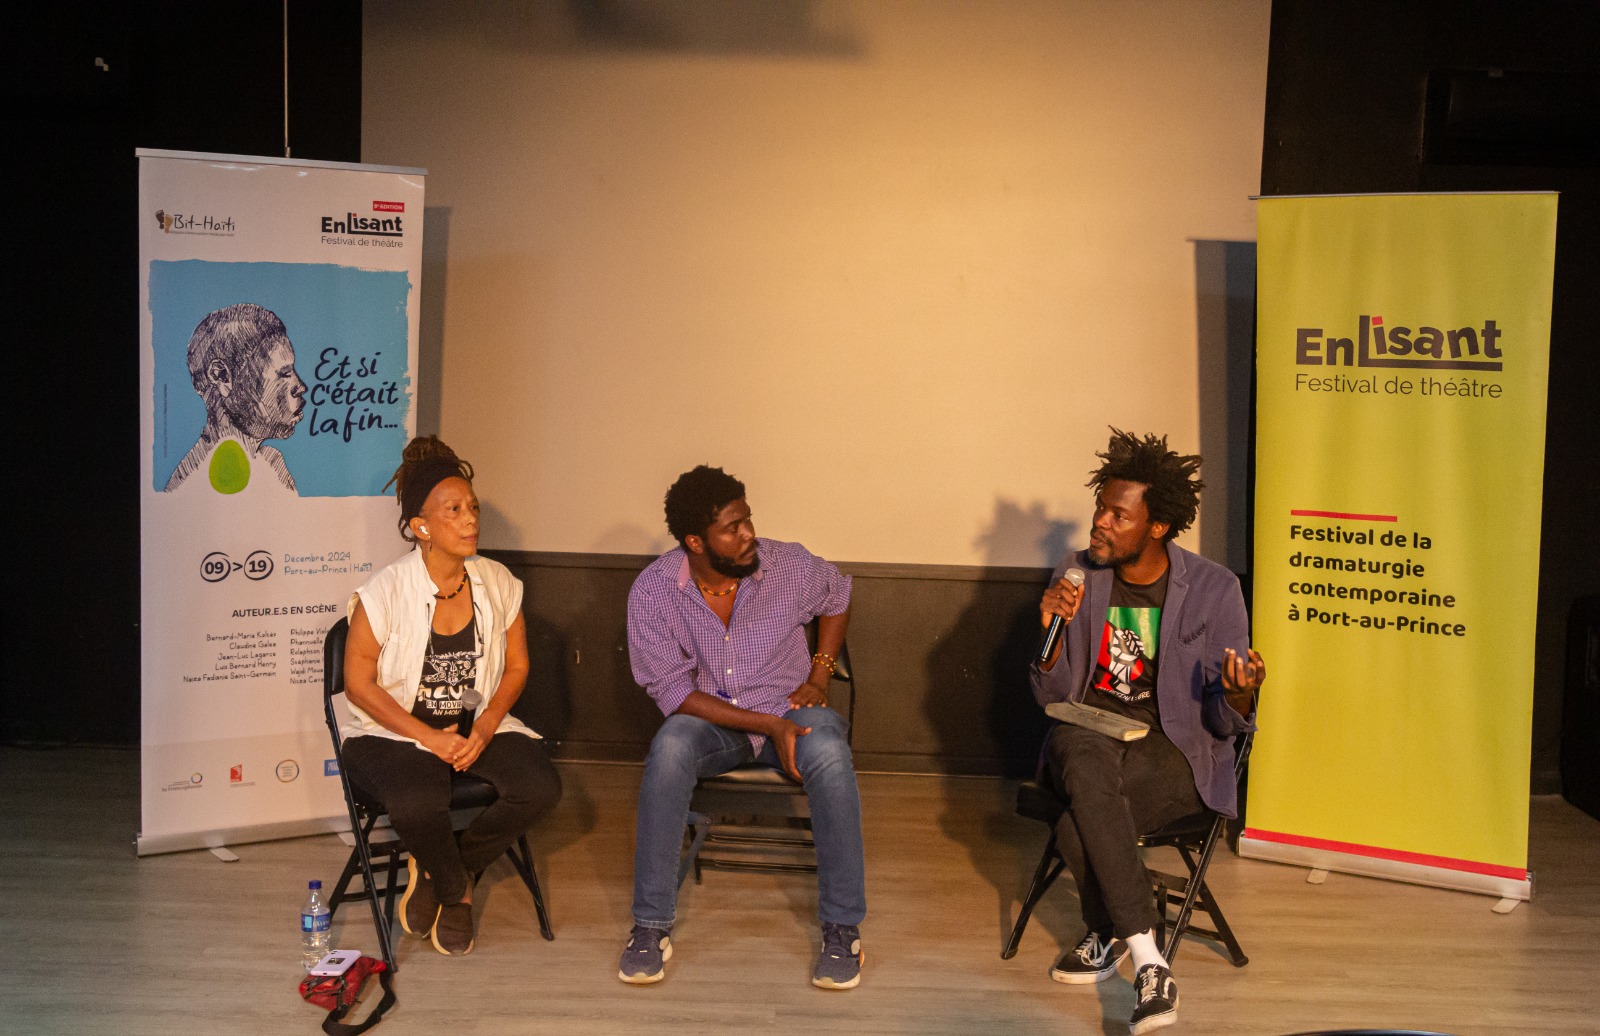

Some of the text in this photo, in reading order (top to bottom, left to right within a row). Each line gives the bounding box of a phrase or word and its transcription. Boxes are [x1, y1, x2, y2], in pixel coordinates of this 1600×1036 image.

[174, 214, 235, 231] Bit-Haïti
[321, 235, 403, 248] Festival de théâtre
[1296, 314, 1503, 371] EnLisant
[314, 346, 382, 382] Et si
[1295, 373, 1503, 398] Festival de théâtre
[309, 407, 339, 436] la
[1290, 524, 1432, 550] Festival de la
[327, 551, 351, 562] 2024
[204, 561, 225, 575] 09
[248, 559, 268, 573] 19
[284, 564, 348, 576] Port-au-Prince
[1288, 551, 1425, 579] dramaturgie
[1288, 581, 1456, 608] contemporaine
[232, 603, 337, 618] AUTEUR.E.S EN SCÈNE
[1287, 603, 1467, 636] à Port-au-Prince
[290, 628, 314, 637] Philippe
[229, 641, 256, 650] Claudine
[218, 651, 249, 661] Jean-Luc
[229, 661, 256, 670] Bernard
[257, 660, 277, 669] Henry
[230, 670, 277, 680] Saint-Germain
